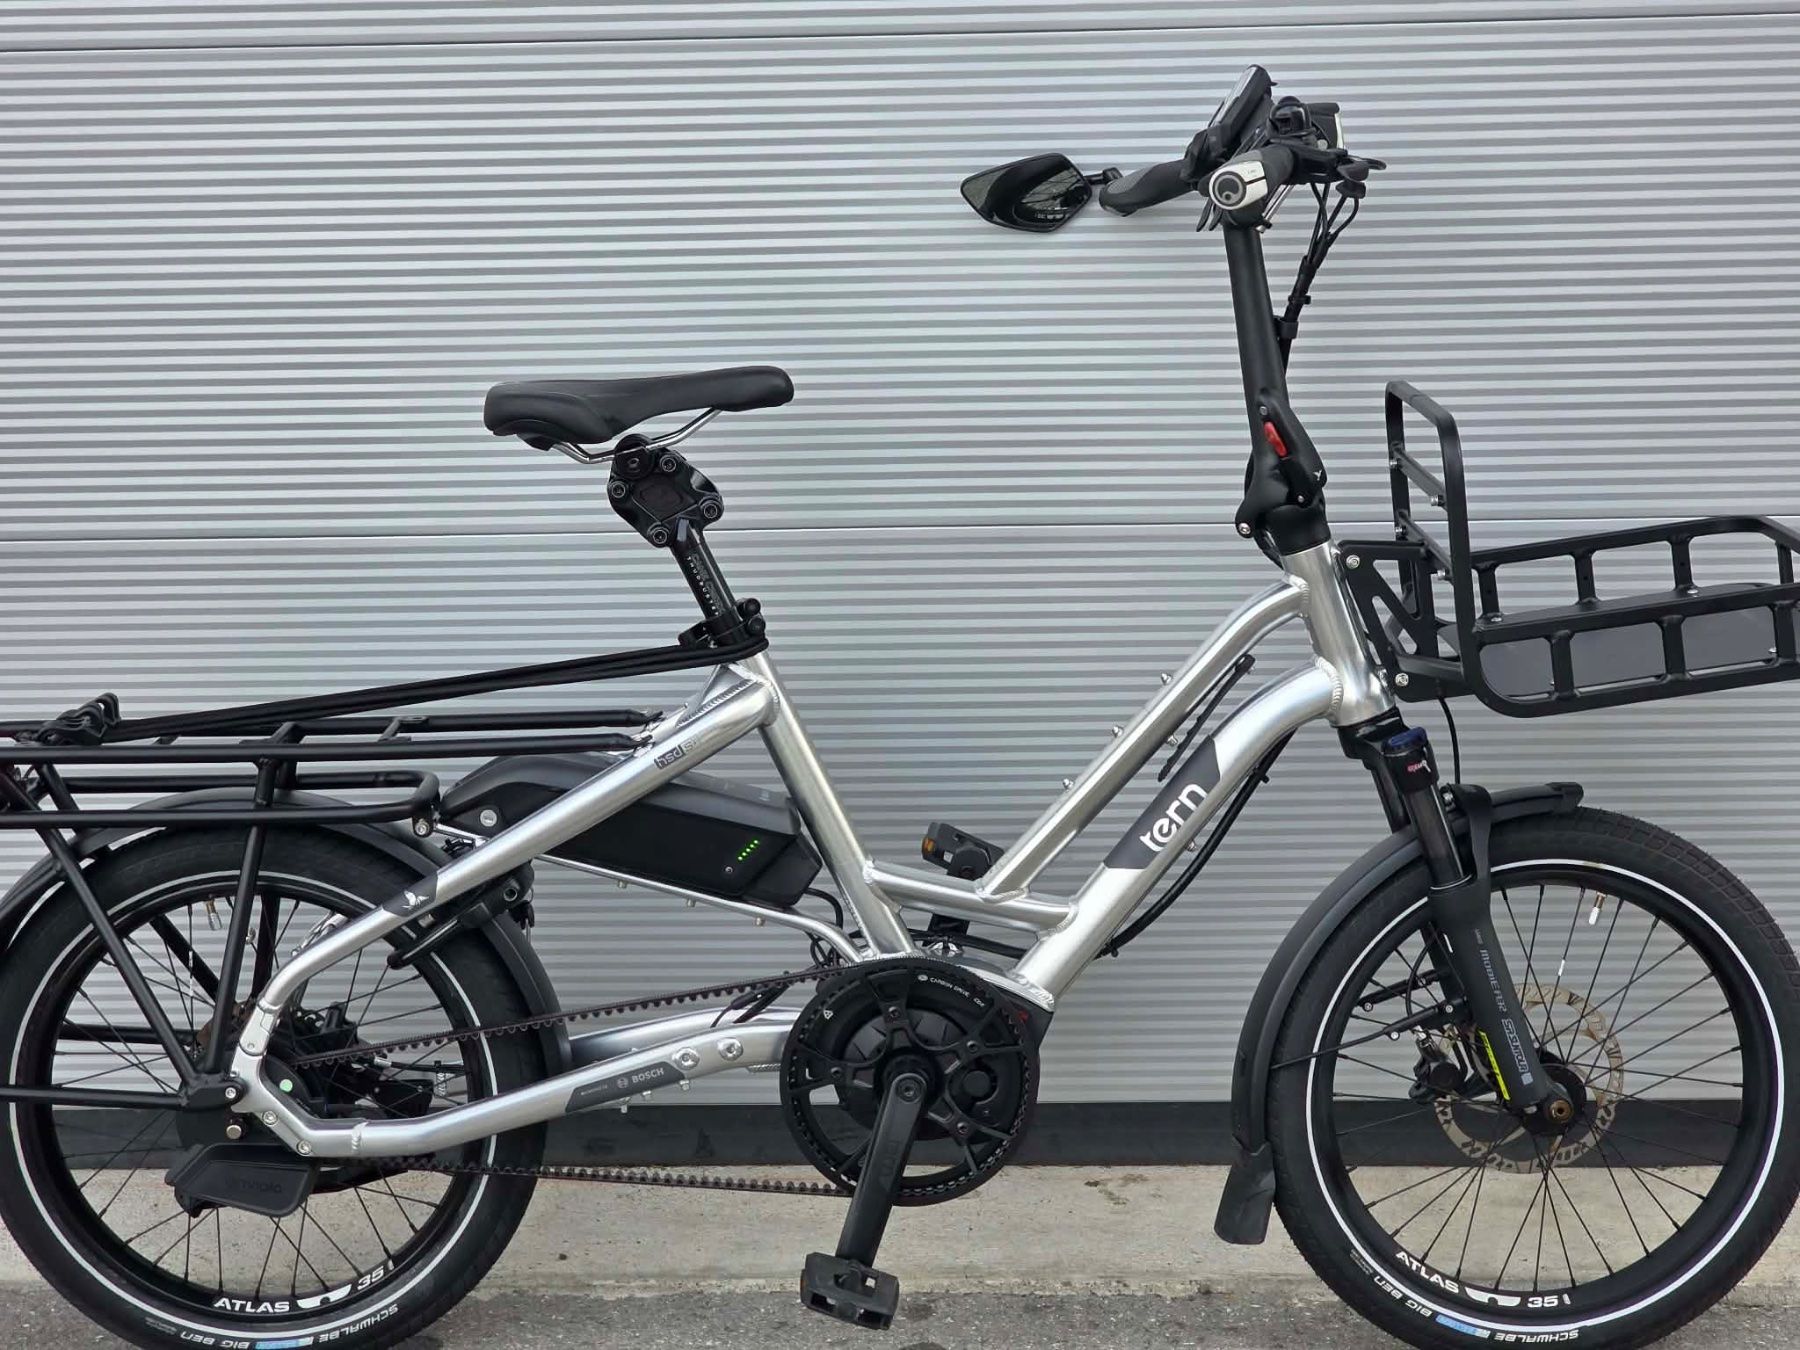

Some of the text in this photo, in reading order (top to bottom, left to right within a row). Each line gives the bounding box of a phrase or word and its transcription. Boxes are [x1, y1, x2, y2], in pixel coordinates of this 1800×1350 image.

[655, 745, 684, 768] hsd
[1139, 784, 1208, 852] tern
[631, 1067, 665, 1084] BOSCH
[213, 1265, 385, 1314] ATLAS 35
[1395, 1250, 1460, 1294] ATLAS
[1526, 1296, 1559, 1309] 35
[318, 1303, 399, 1343] SCHWALBE
[1373, 1275, 1580, 1343] SCHWALBE BIG BEN
[179, 1330, 216, 1346] BEN
[220, 1339, 251, 1350] BIG
